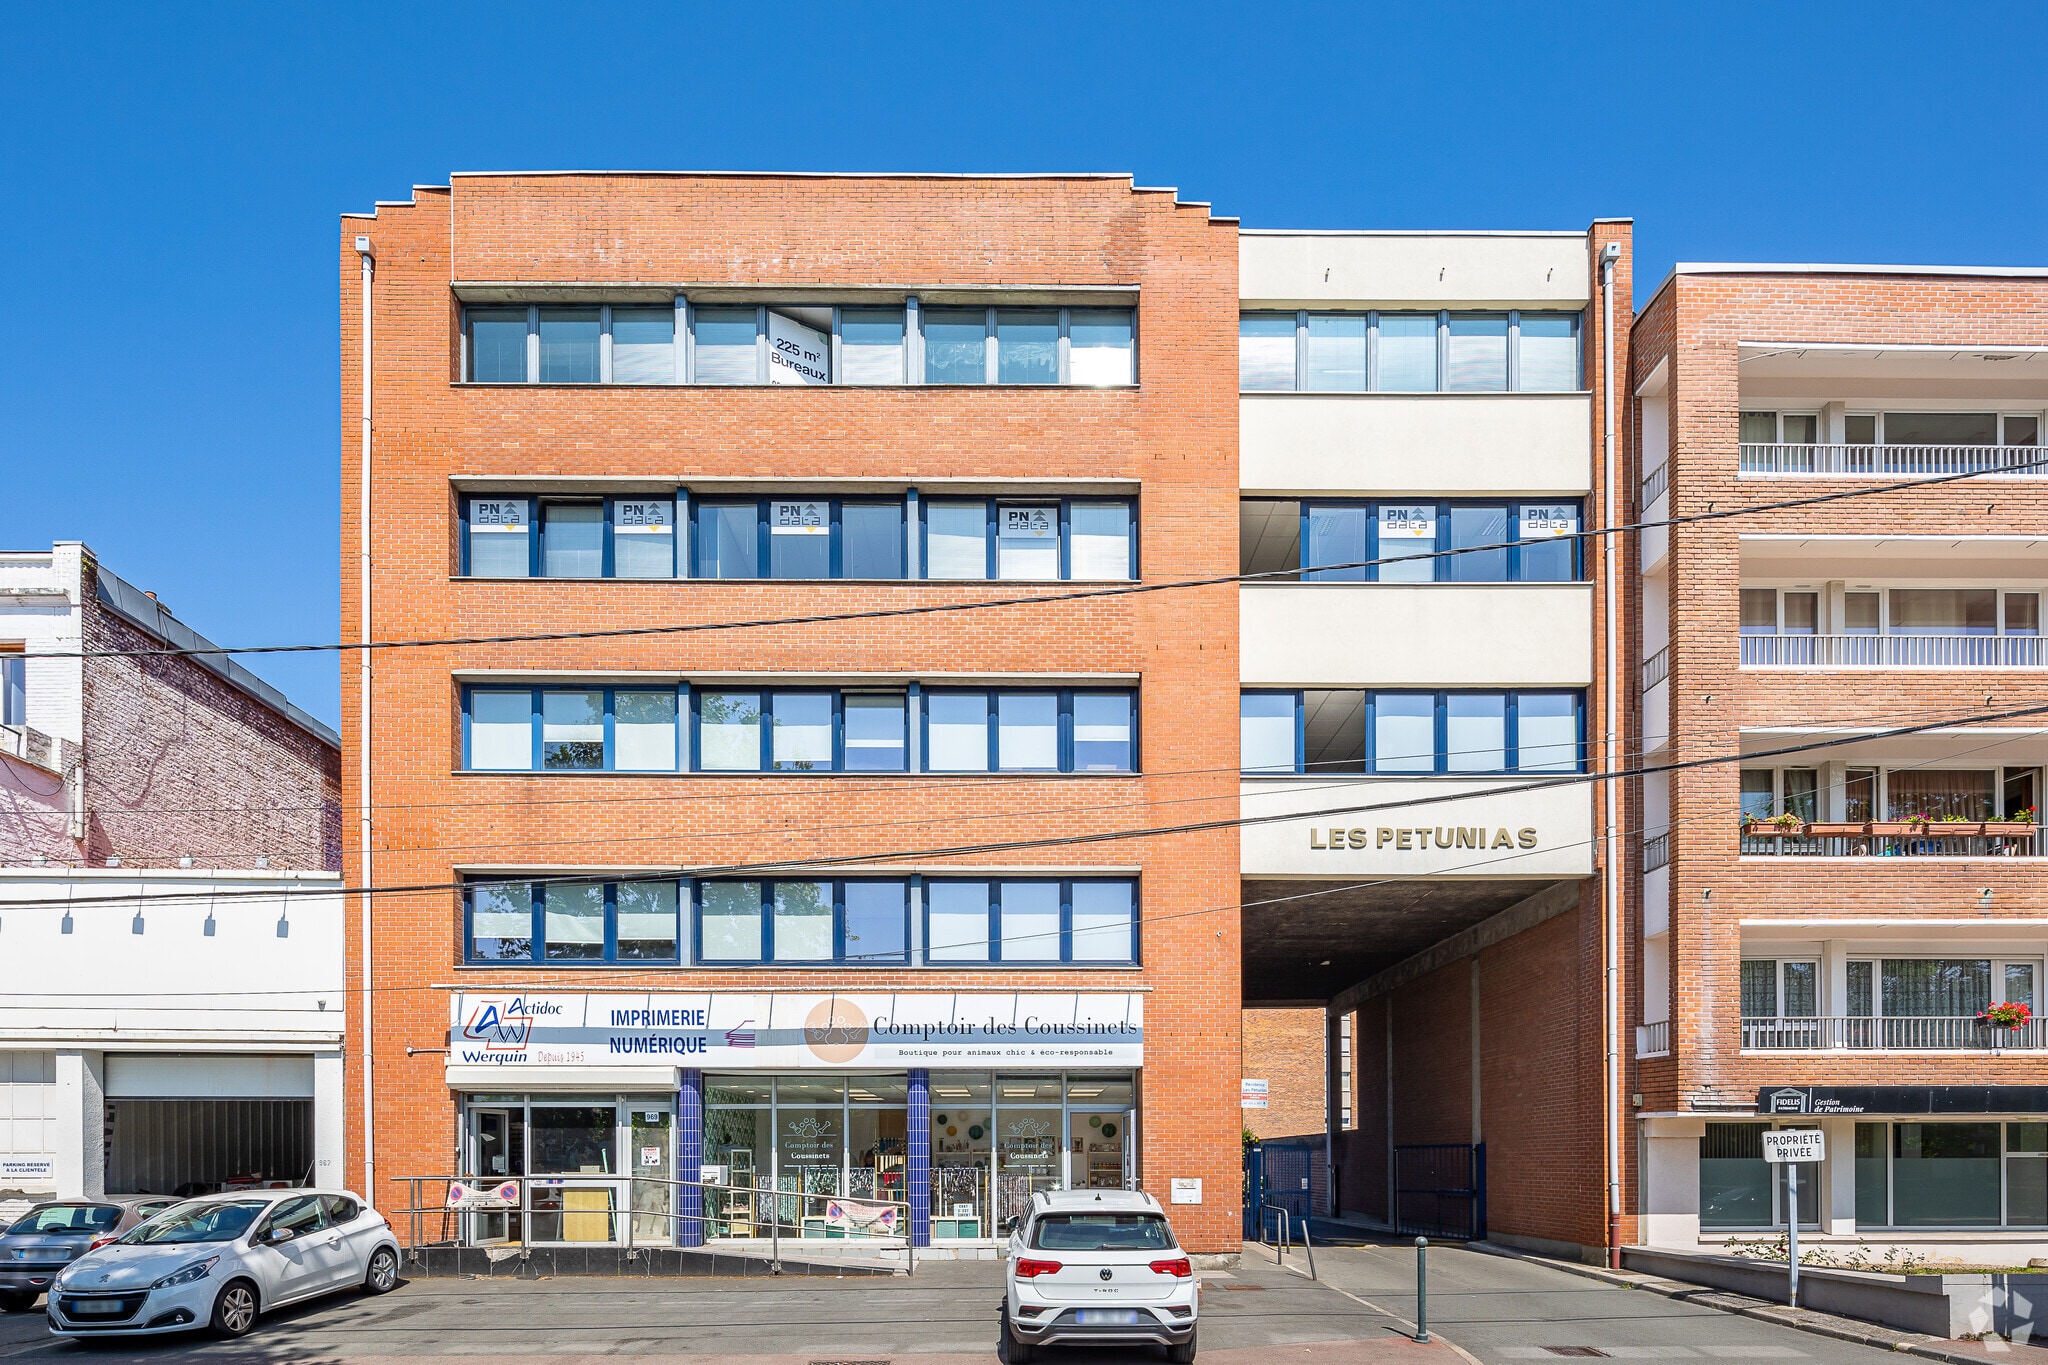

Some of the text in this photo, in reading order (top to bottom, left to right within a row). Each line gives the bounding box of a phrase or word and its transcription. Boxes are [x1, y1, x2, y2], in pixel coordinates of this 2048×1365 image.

[776, 338, 800, 356] 225
[771, 352, 826, 381] Bureaux
[479, 504, 500, 514] PN
[623, 505, 644, 515] PN
[780, 506, 801, 516] PN
[479, 515, 520, 524] data
[1009, 512, 1030, 521] PN
[1387, 510, 1408, 519] PN
[1528, 510, 1549, 519] PN
[623, 516, 663, 525] data
[780, 517, 820, 526] data
[1387, 520, 1427, 530] data
[1528, 520, 1568, 529] data
[1009, 522, 1048, 530] data
[1310, 827, 1538, 850] LES PETUNIAS
[508, 998, 563, 1015] Actidoc
[611, 1010, 705, 1026] IMPRIMERIE
[873, 1016, 1138, 1041] Comptoir des Coussinets
[610, 1034, 707, 1055] NUMÉRIQUE
[462, 1050, 528, 1066] Werquin
[538, 1051, 563, 1066] Depuis
[898, 1049, 938, 1058] Boutique
[942, 1050, 962, 1058] pour
[1039, 1049, 1114, 1057] éco-responsable
[1814, 1098, 1841, 1107] Gestion
[1814, 1105, 1865, 1113] de Patrimoine
[646, 1113, 658, 1121] 969
[1766, 1132, 1821, 1146] PROPRIÉTÉ
[784, 1141, 834, 1151] Comptoir des
[1004, 1141, 1053, 1151] Comptoir des
[791, 1151, 830, 1159] Coussinets
[1010, 1151, 1049, 1160] Coussinets
[1776, 1145, 1812, 1158] PRIVÉE
